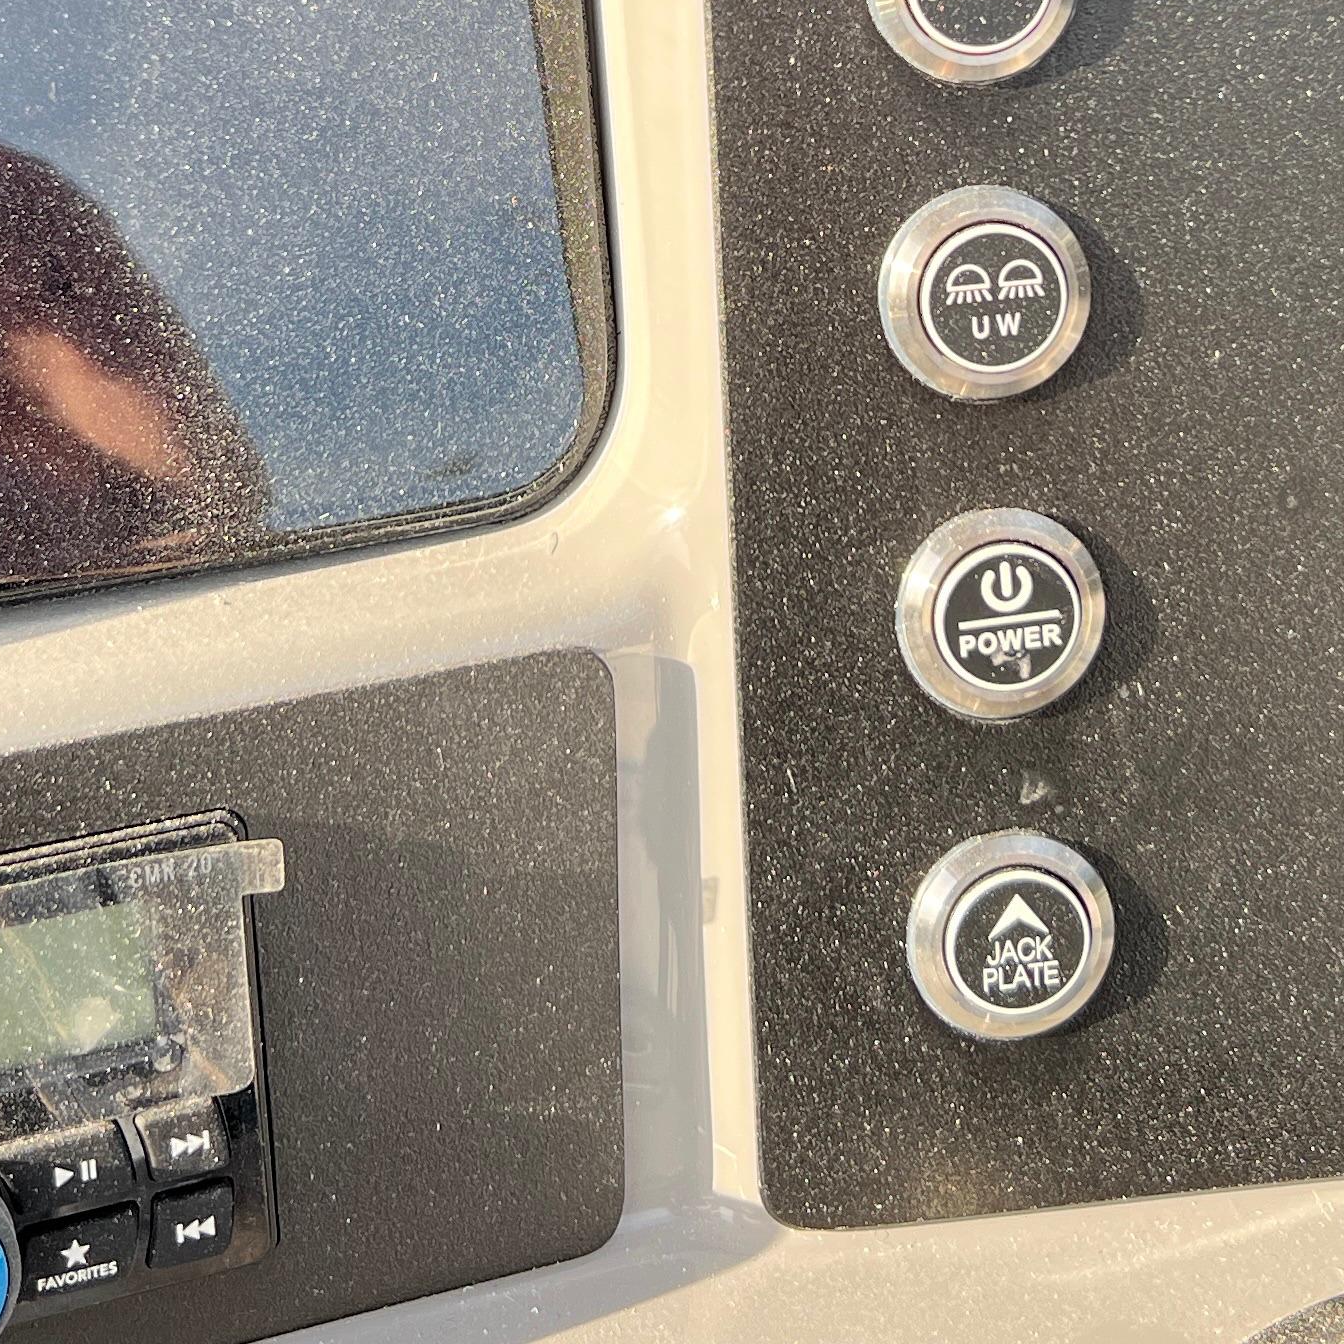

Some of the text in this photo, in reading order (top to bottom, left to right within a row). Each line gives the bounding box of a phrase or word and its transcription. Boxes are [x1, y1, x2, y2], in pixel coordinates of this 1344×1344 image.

[971, 311, 1022, 340] U W
[958, 623, 1064, 659] POWER
[986, 934, 1054, 966] JACK
[982, 959, 1061, 995] PLATE
[37, 1260, 118, 1292] FAVORITES
